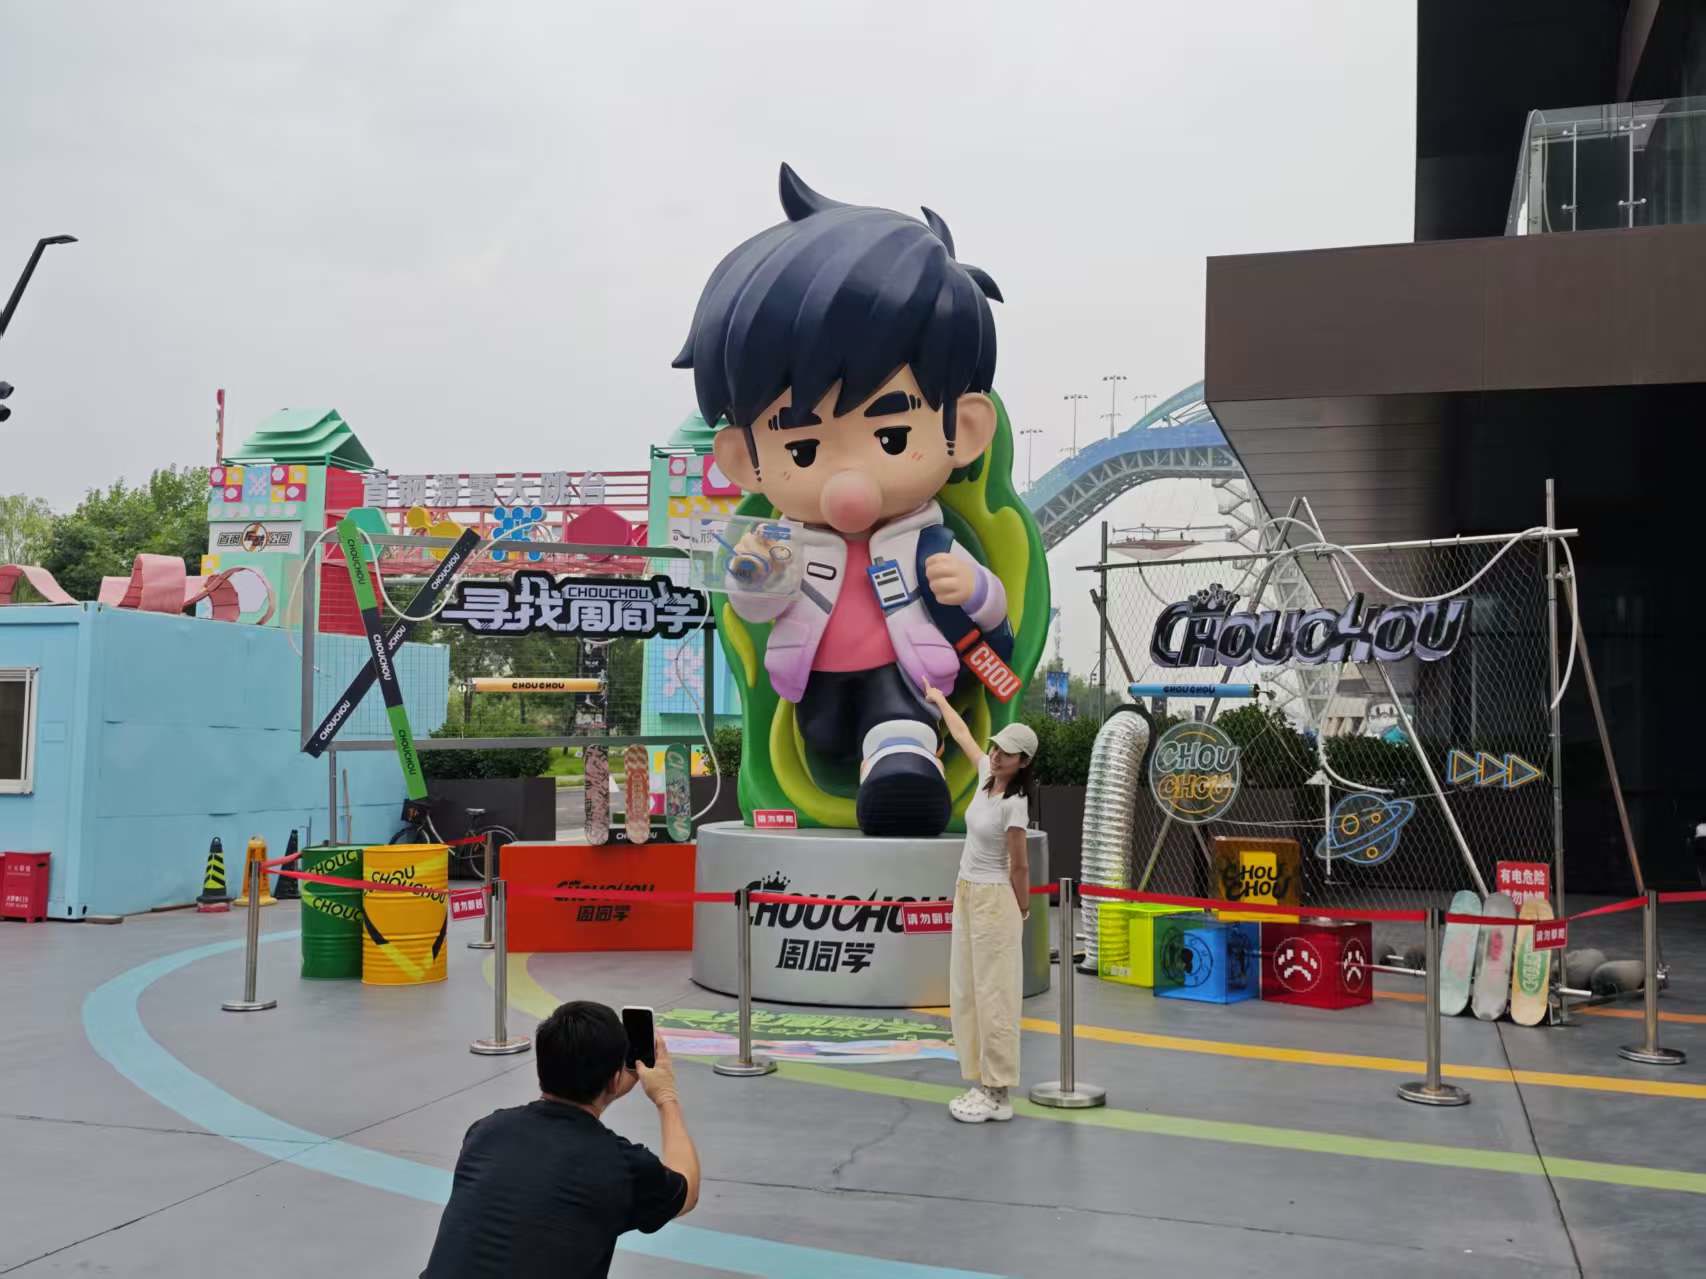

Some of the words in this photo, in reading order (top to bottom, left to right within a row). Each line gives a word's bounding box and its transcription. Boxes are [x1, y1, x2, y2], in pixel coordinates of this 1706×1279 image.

[363, 471, 606, 507] 首钢滑雪大跳台
[347, 538, 366, 585] CHOUCHOU
[431, 553, 460, 590] CHOUCHOU
[441, 575, 714, 633] 寻找周同学
[568, 586, 650, 598] CHOUCHOU
[1150, 592, 1473, 668] CHOUCHOU
[372, 633, 393, 682] CHOUCHOU
[969, 646, 1019, 697] CHOU
[511, 682, 565, 690] CHOUCHOU
[1163, 685, 1217, 694] CHOUCHOU
[319, 699, 351, 741] CHOUCHOU
[398, 729, 417, 776] CHOUCHOU
[1155, 739, 1240, 773] CHOU
[1158, 773, 1232, 803] CHOU
[1223, 863, 1286, 881] CHOU
[1225, 879, 1289, 901] CHOU
[1500, 868, 1545, 885] 有电危险
[576, 904, 631, 922] 周同学
[775, 938, 875, 974] 周同学
